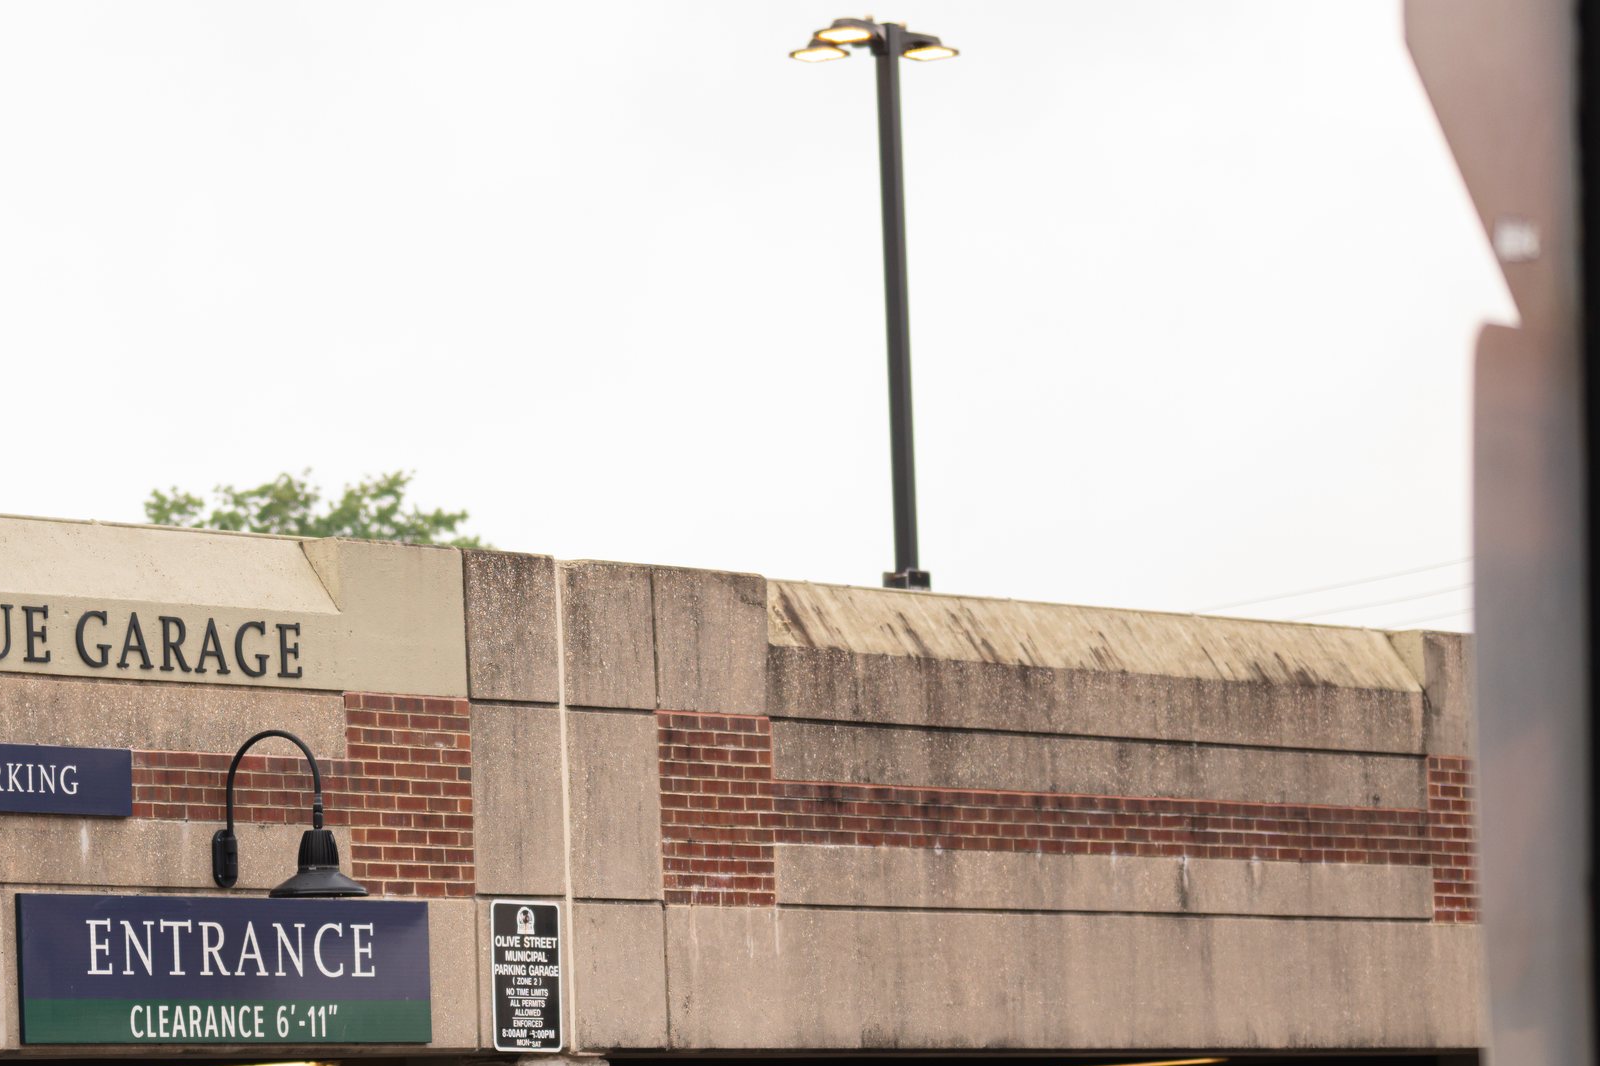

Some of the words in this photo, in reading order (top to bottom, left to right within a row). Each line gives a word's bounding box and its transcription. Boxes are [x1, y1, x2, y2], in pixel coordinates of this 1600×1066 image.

[75, 610, 303, 680] GARAGE
[86, 918, 376, 978] ENTRANCE
[495, 936, 520, 947] OLIVE
[524, 937, 557, 949] STREET
[505, 951, 548, 962] MUNICIPAL
[494, 964, 526, 975] PARKING
[529, 965, 558, 976] GARAGE
[506, 988, 514, 996] NO
[517, 988, 529, 996] TIME
[531, 988, 548, 996] LIMITS
[522, 1000, 545, 1008] PERMITS
[515, 1009, 541, 1017] ALLOWED
[130, 1005, 264, 1040] CLEARANCE
[276, 1005, 338, 1038] 6'-11"
[513, 1020, 543, 1028] ENFORCED
[502, 1029, 527, 1038] 8:00AM
